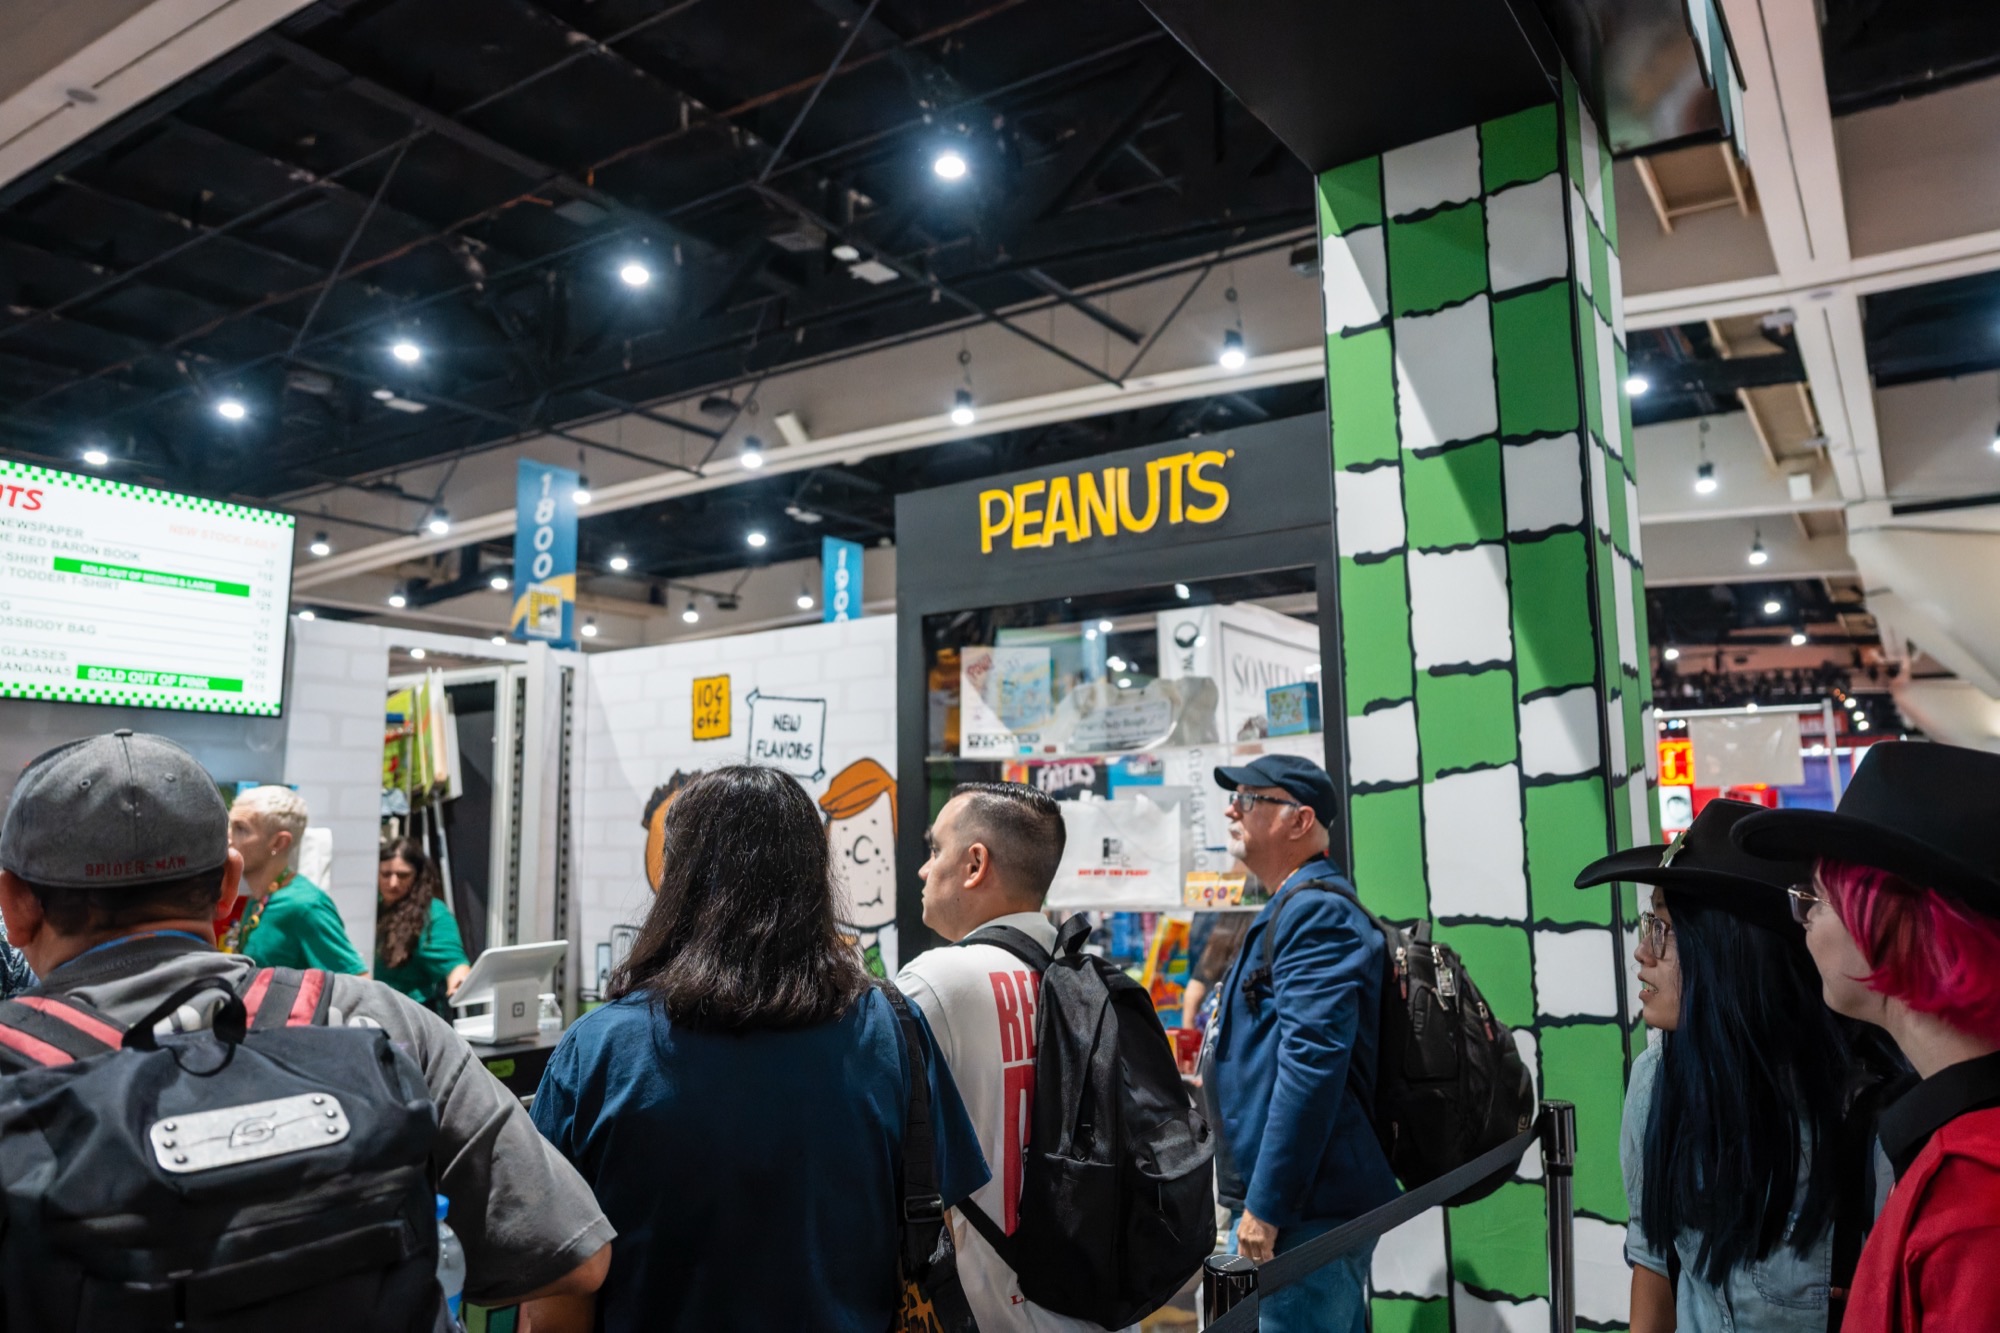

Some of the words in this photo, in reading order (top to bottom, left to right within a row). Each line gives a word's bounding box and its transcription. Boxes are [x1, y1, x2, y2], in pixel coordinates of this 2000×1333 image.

[0, 484, 43, 511] TS
[979, 450, 1229, 554] PEANUTS
[534, 473, 554, 579] 1800
[18, 533, 47, 548] RED
[51, 538, 99, 555] BARON
[103, 546, 141, 561] BOOK
[71, 575, 120, 592] T-SHIRT
[107, 567, 128, 580] OUT
[128, 570, 142, 581] OF
[68, 620, 96, 636] BAG
[1, 645, 67, 662] GLASSES
[0, 661, 72, 677] ANDANAS
[88, 668, 126, 683] SOLD
[128, 671, 157, 685] OUT
[158, 674, 177, 686] OF
[179, 675, 209, 690] PINK
[773, 714, 801, 732] NEW
[756, 738, 813, 760] FLAVORS
[84, 855, 187, 877] SPIDER-MAN
